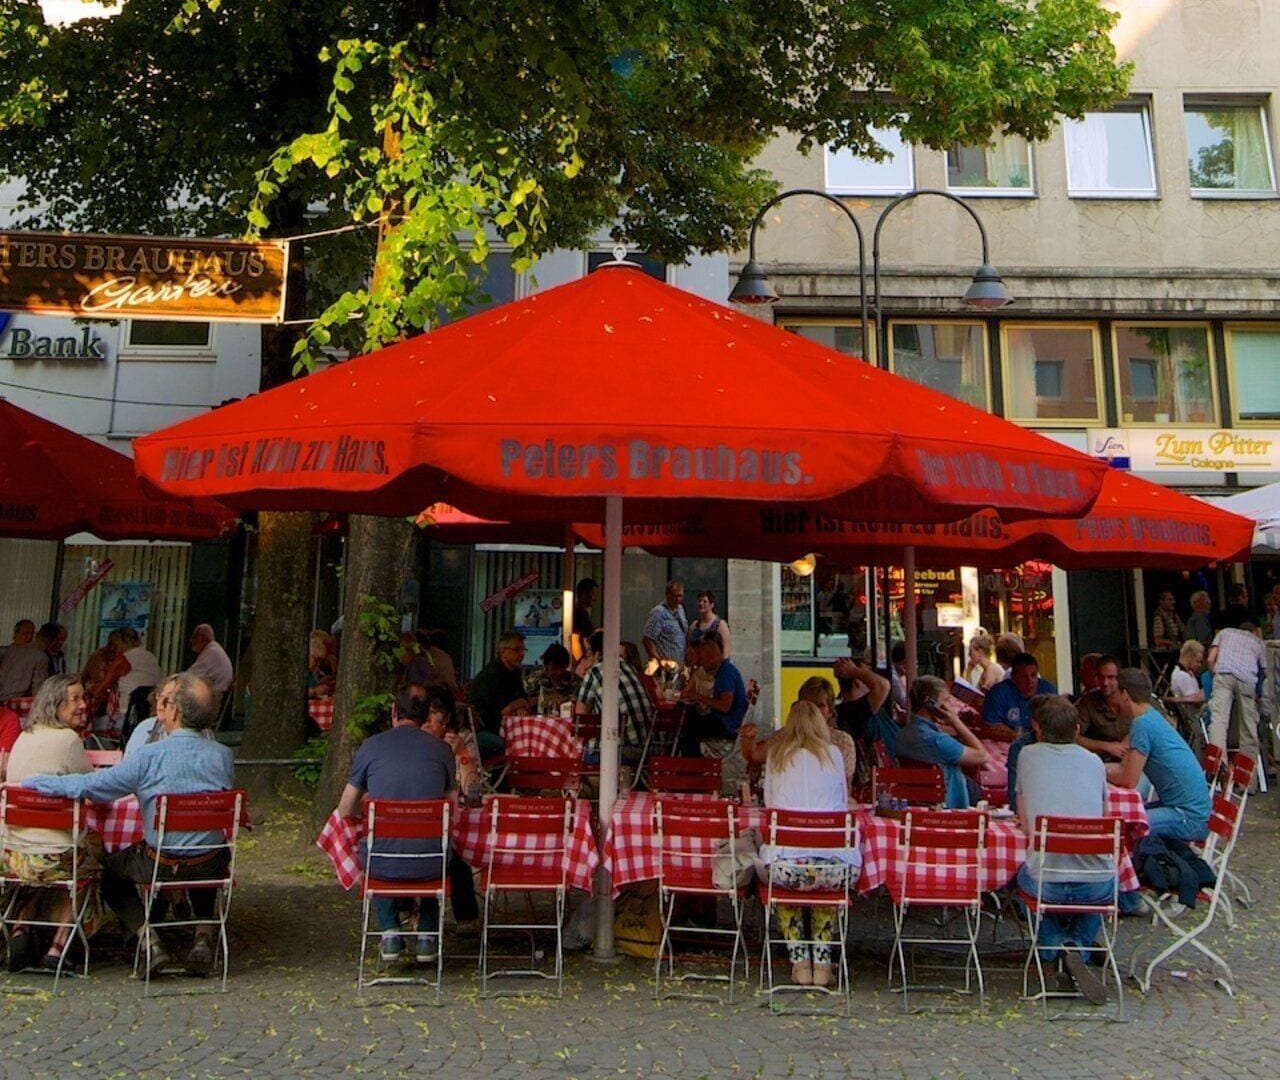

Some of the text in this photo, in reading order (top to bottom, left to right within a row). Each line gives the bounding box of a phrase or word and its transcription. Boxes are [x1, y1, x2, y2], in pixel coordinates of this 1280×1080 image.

[83, 244, 266, 278] BRAUHAUS
[81, 274, 245, 312] Garten
[7, 327, 106, 360] Bank
[160, 433, 390, 482] Hier ist Köln zu Haus.
[500, 437, 815, 487] Peters Brauhaus.
[1156, 431, 1273, 461] Zum Pitter
[1191, 458, 1236, 470] Cologne
[759, 508, 810, 536] Hier
[1075, 516, 1128, 541] Peters
